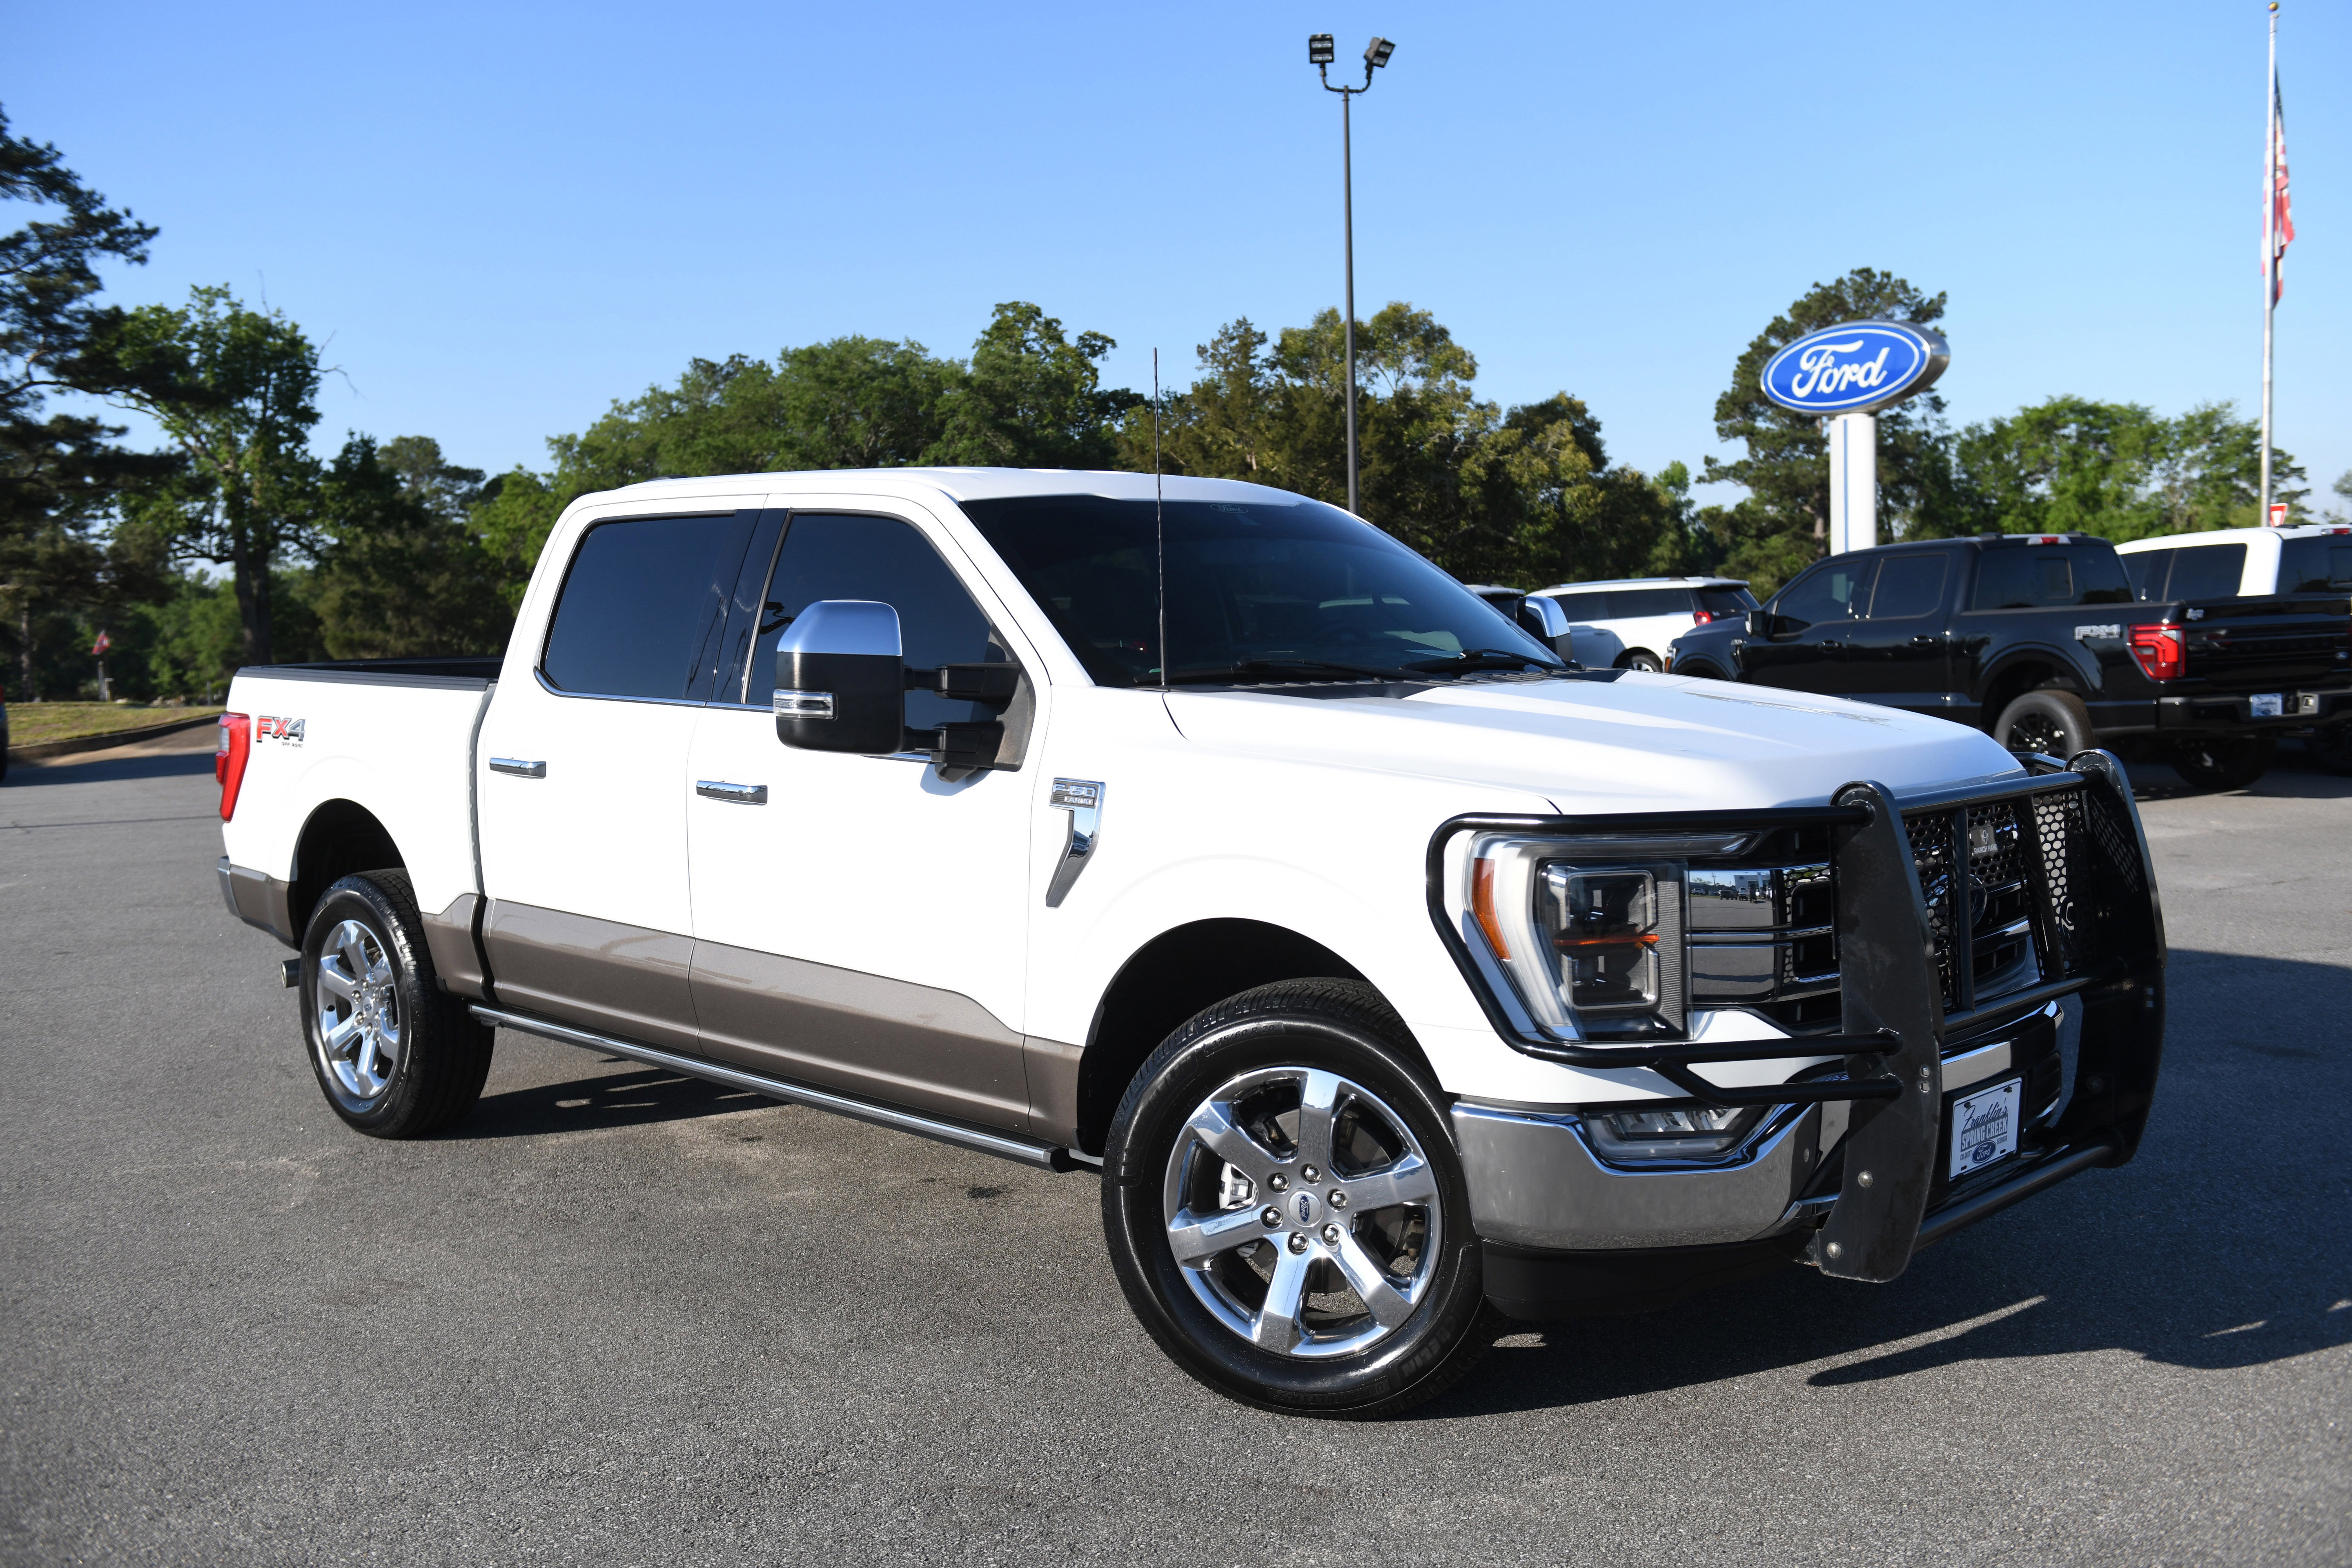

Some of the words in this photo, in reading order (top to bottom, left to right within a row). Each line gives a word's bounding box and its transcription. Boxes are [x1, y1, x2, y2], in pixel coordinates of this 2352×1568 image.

[1791, 339, 1890, 398] Ford
[2075, 624, 2120, 640] FX4
[256, 715, 306, 743] FX4
[1052, 783, 1096, 797] F-150
[1064, 796, 1093, 804] LARIAT
[1973, 845, 1988, 854] RANCH
[1987, 843, 1998, 851] HAND
[1212, 1029, 1247, 1049] 275/60
[1251, 1027, 1258, 1036] R
[1261, 1025, 1275, 1034] 20
[1962, 1097, 2009, 1132] Franklin's
[1962, 1125, 1985, 1150] SPRING
[1986, 1117, 2008, 1139] CREEK
[1997, 1135, 2008, 1145] GEORGIA
[1960, 1149, 1972, 1161] COLQUITT
[1976, 1144, 1992, 1160] Ford
[1301, 1199, 1309, 1218] Ford
